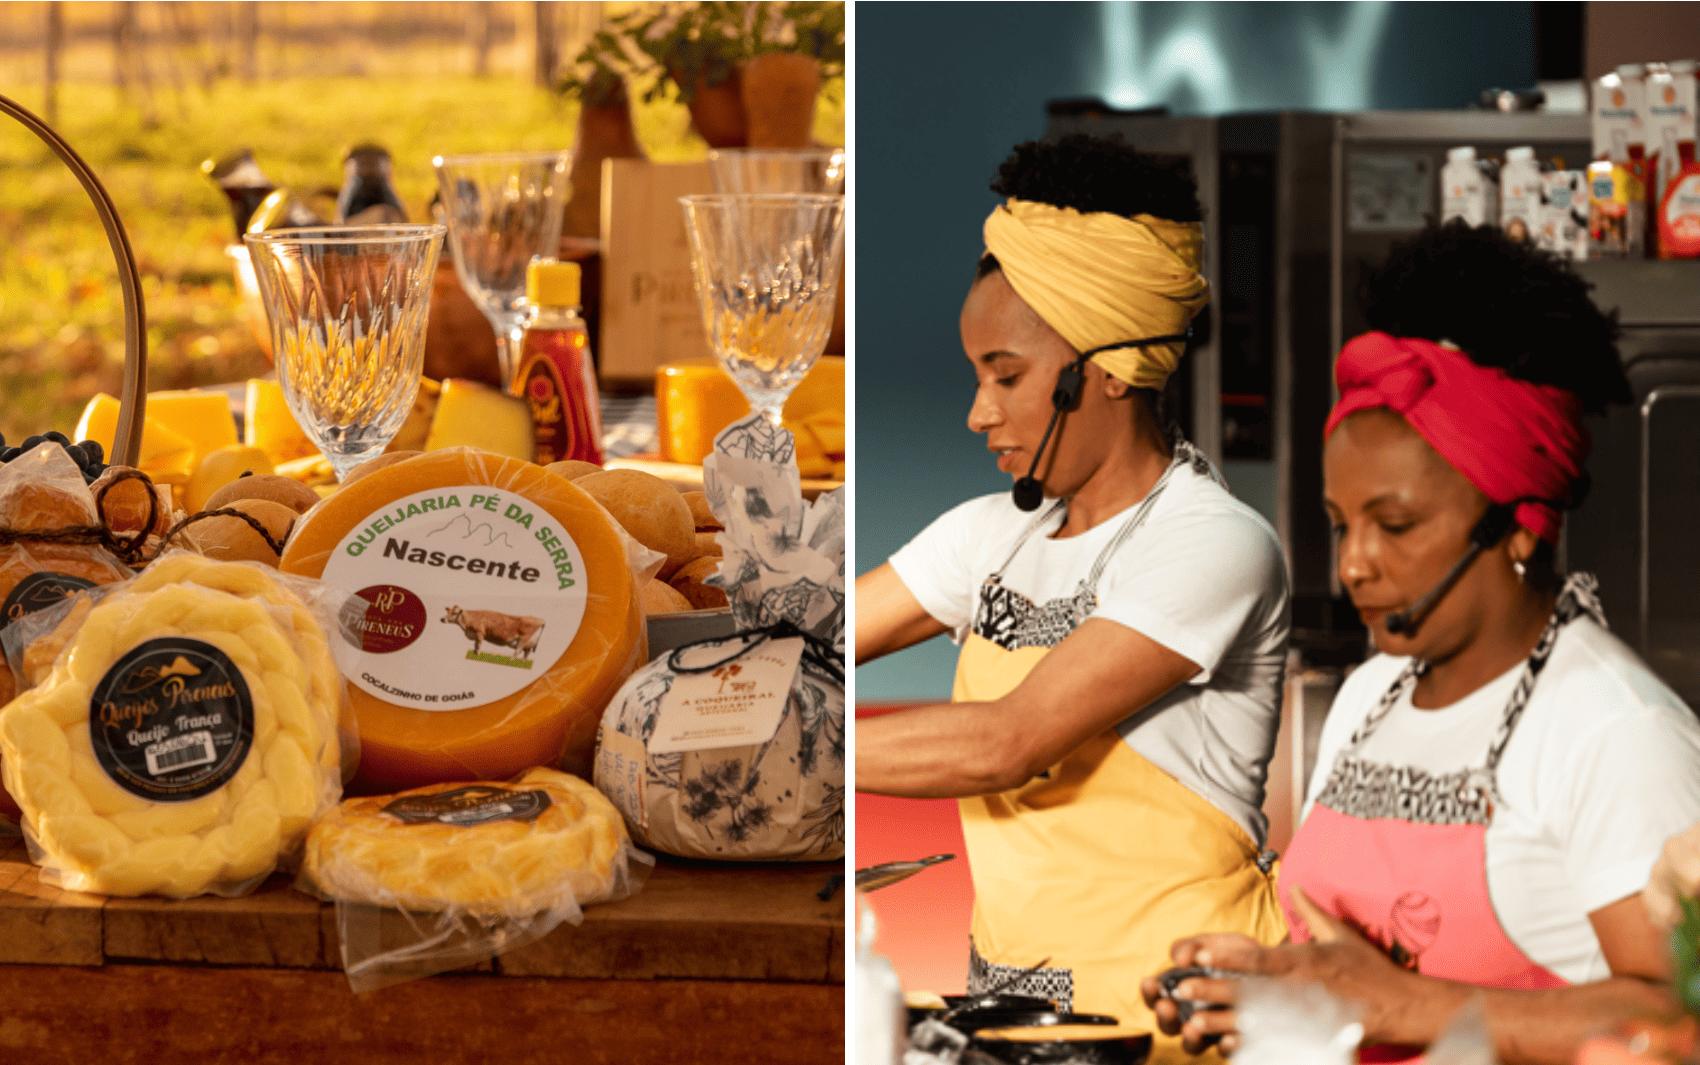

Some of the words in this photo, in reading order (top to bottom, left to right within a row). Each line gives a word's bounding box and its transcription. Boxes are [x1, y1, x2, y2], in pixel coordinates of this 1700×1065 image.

[346, 494, 461, 557] QUEIJARIA
[469, 493, 501, 512] PÉ
[503, 503, 533, 529] DA
[534, 526, 575, 590] SERRA
[383, 537, 541, 583] Nascente
[361, 672, 422, 701] COCALZINHO
[424, 694, 438, 702] DE
[441, 691, 475, 702] GOIÁS
[127, 725, 170, 746] Queijo
[174, 713, 222, 730] Trança
